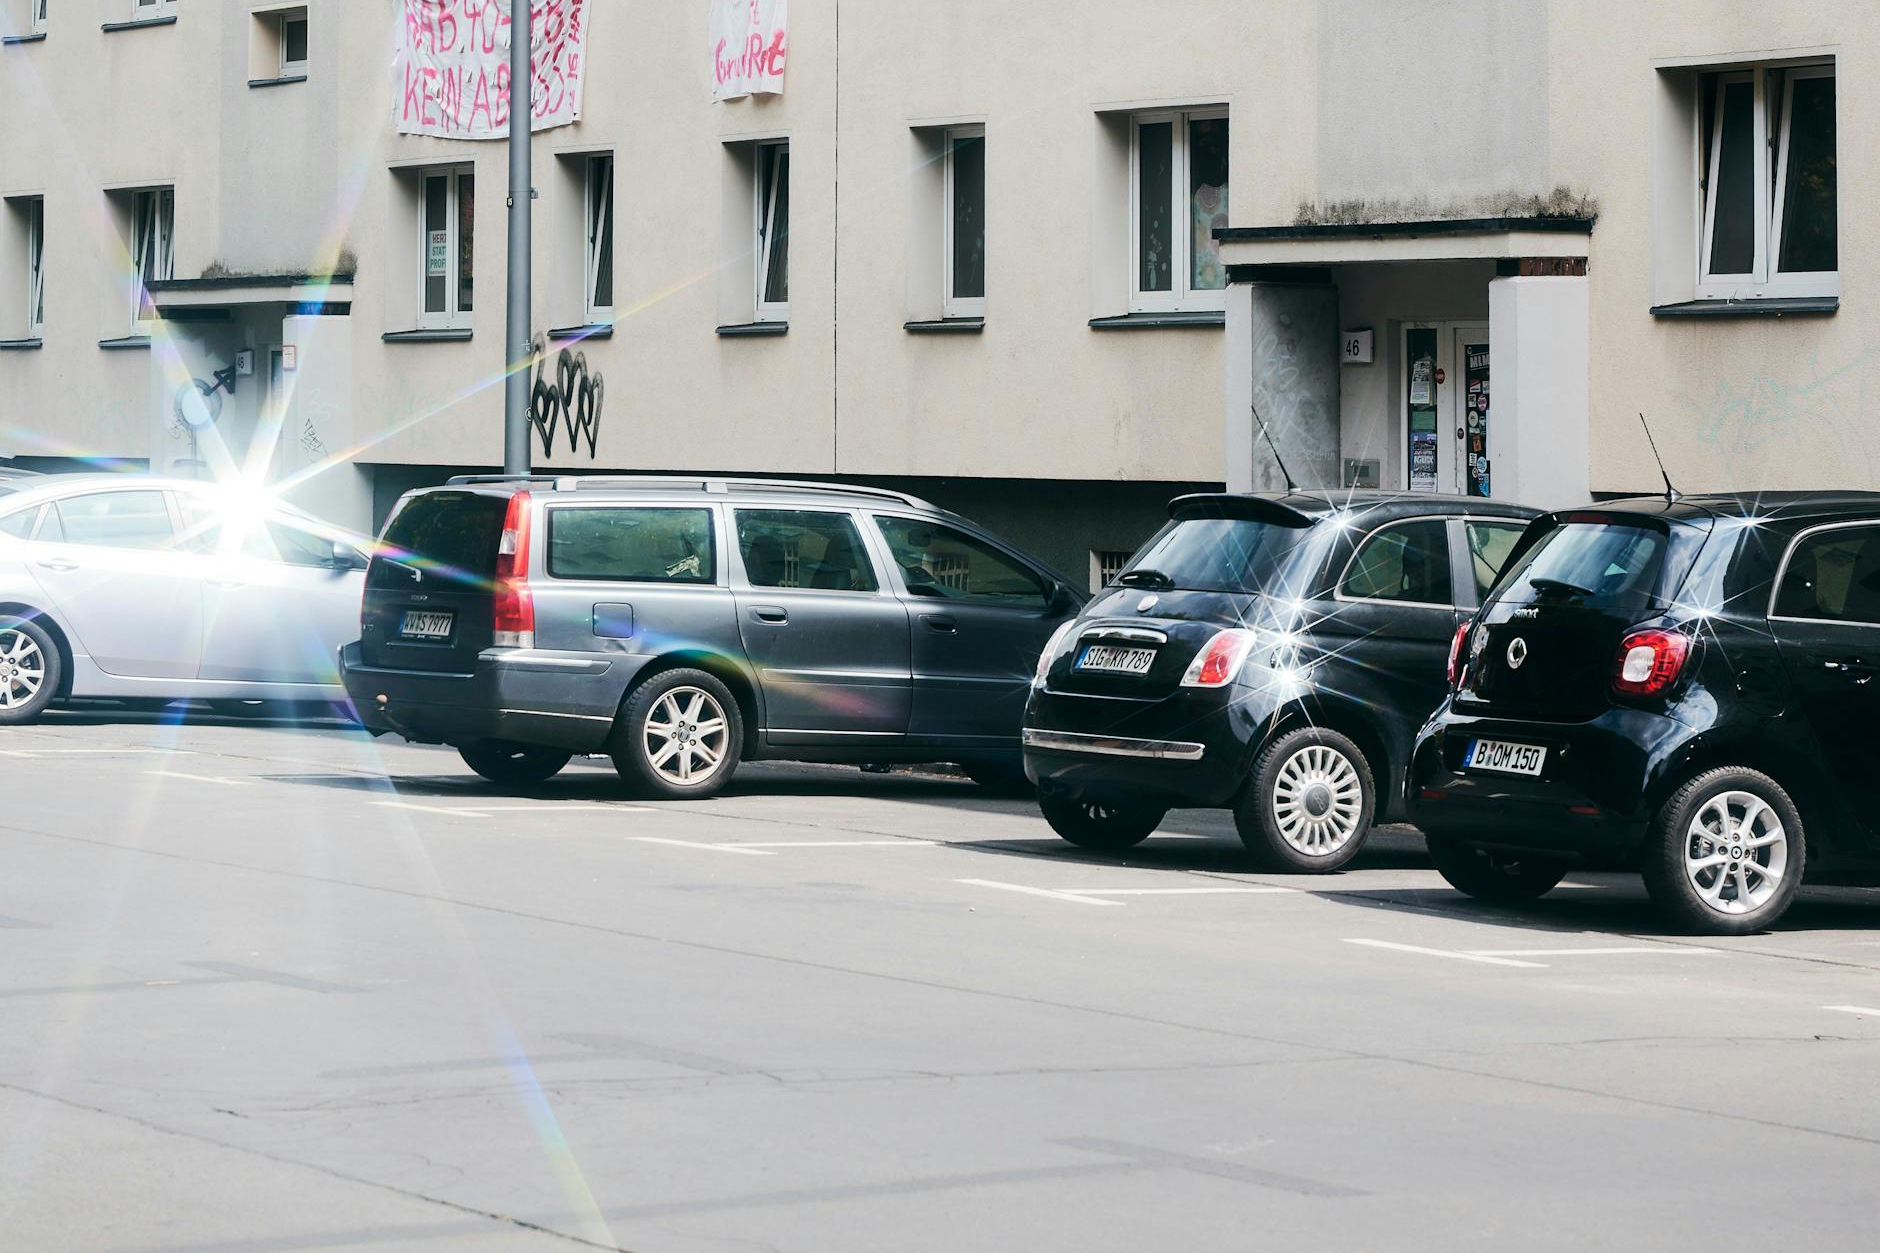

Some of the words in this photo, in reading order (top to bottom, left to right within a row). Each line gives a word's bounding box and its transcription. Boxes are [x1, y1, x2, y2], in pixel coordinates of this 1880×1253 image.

[403, 59, 463, 132] KEIN
[1346, 339, 1360, 356] 46
[428, 614, 451, 634] 7977
[1083, 648, 1108, 667] SIG
[1109, 649, 1130, 668] KR
[1127, 651, 1153, 670] 789
[1475, 743, 1488, 764] B
[1493, 744, 1514, 767] OM
[1511, 747, 1540, 771] 150
